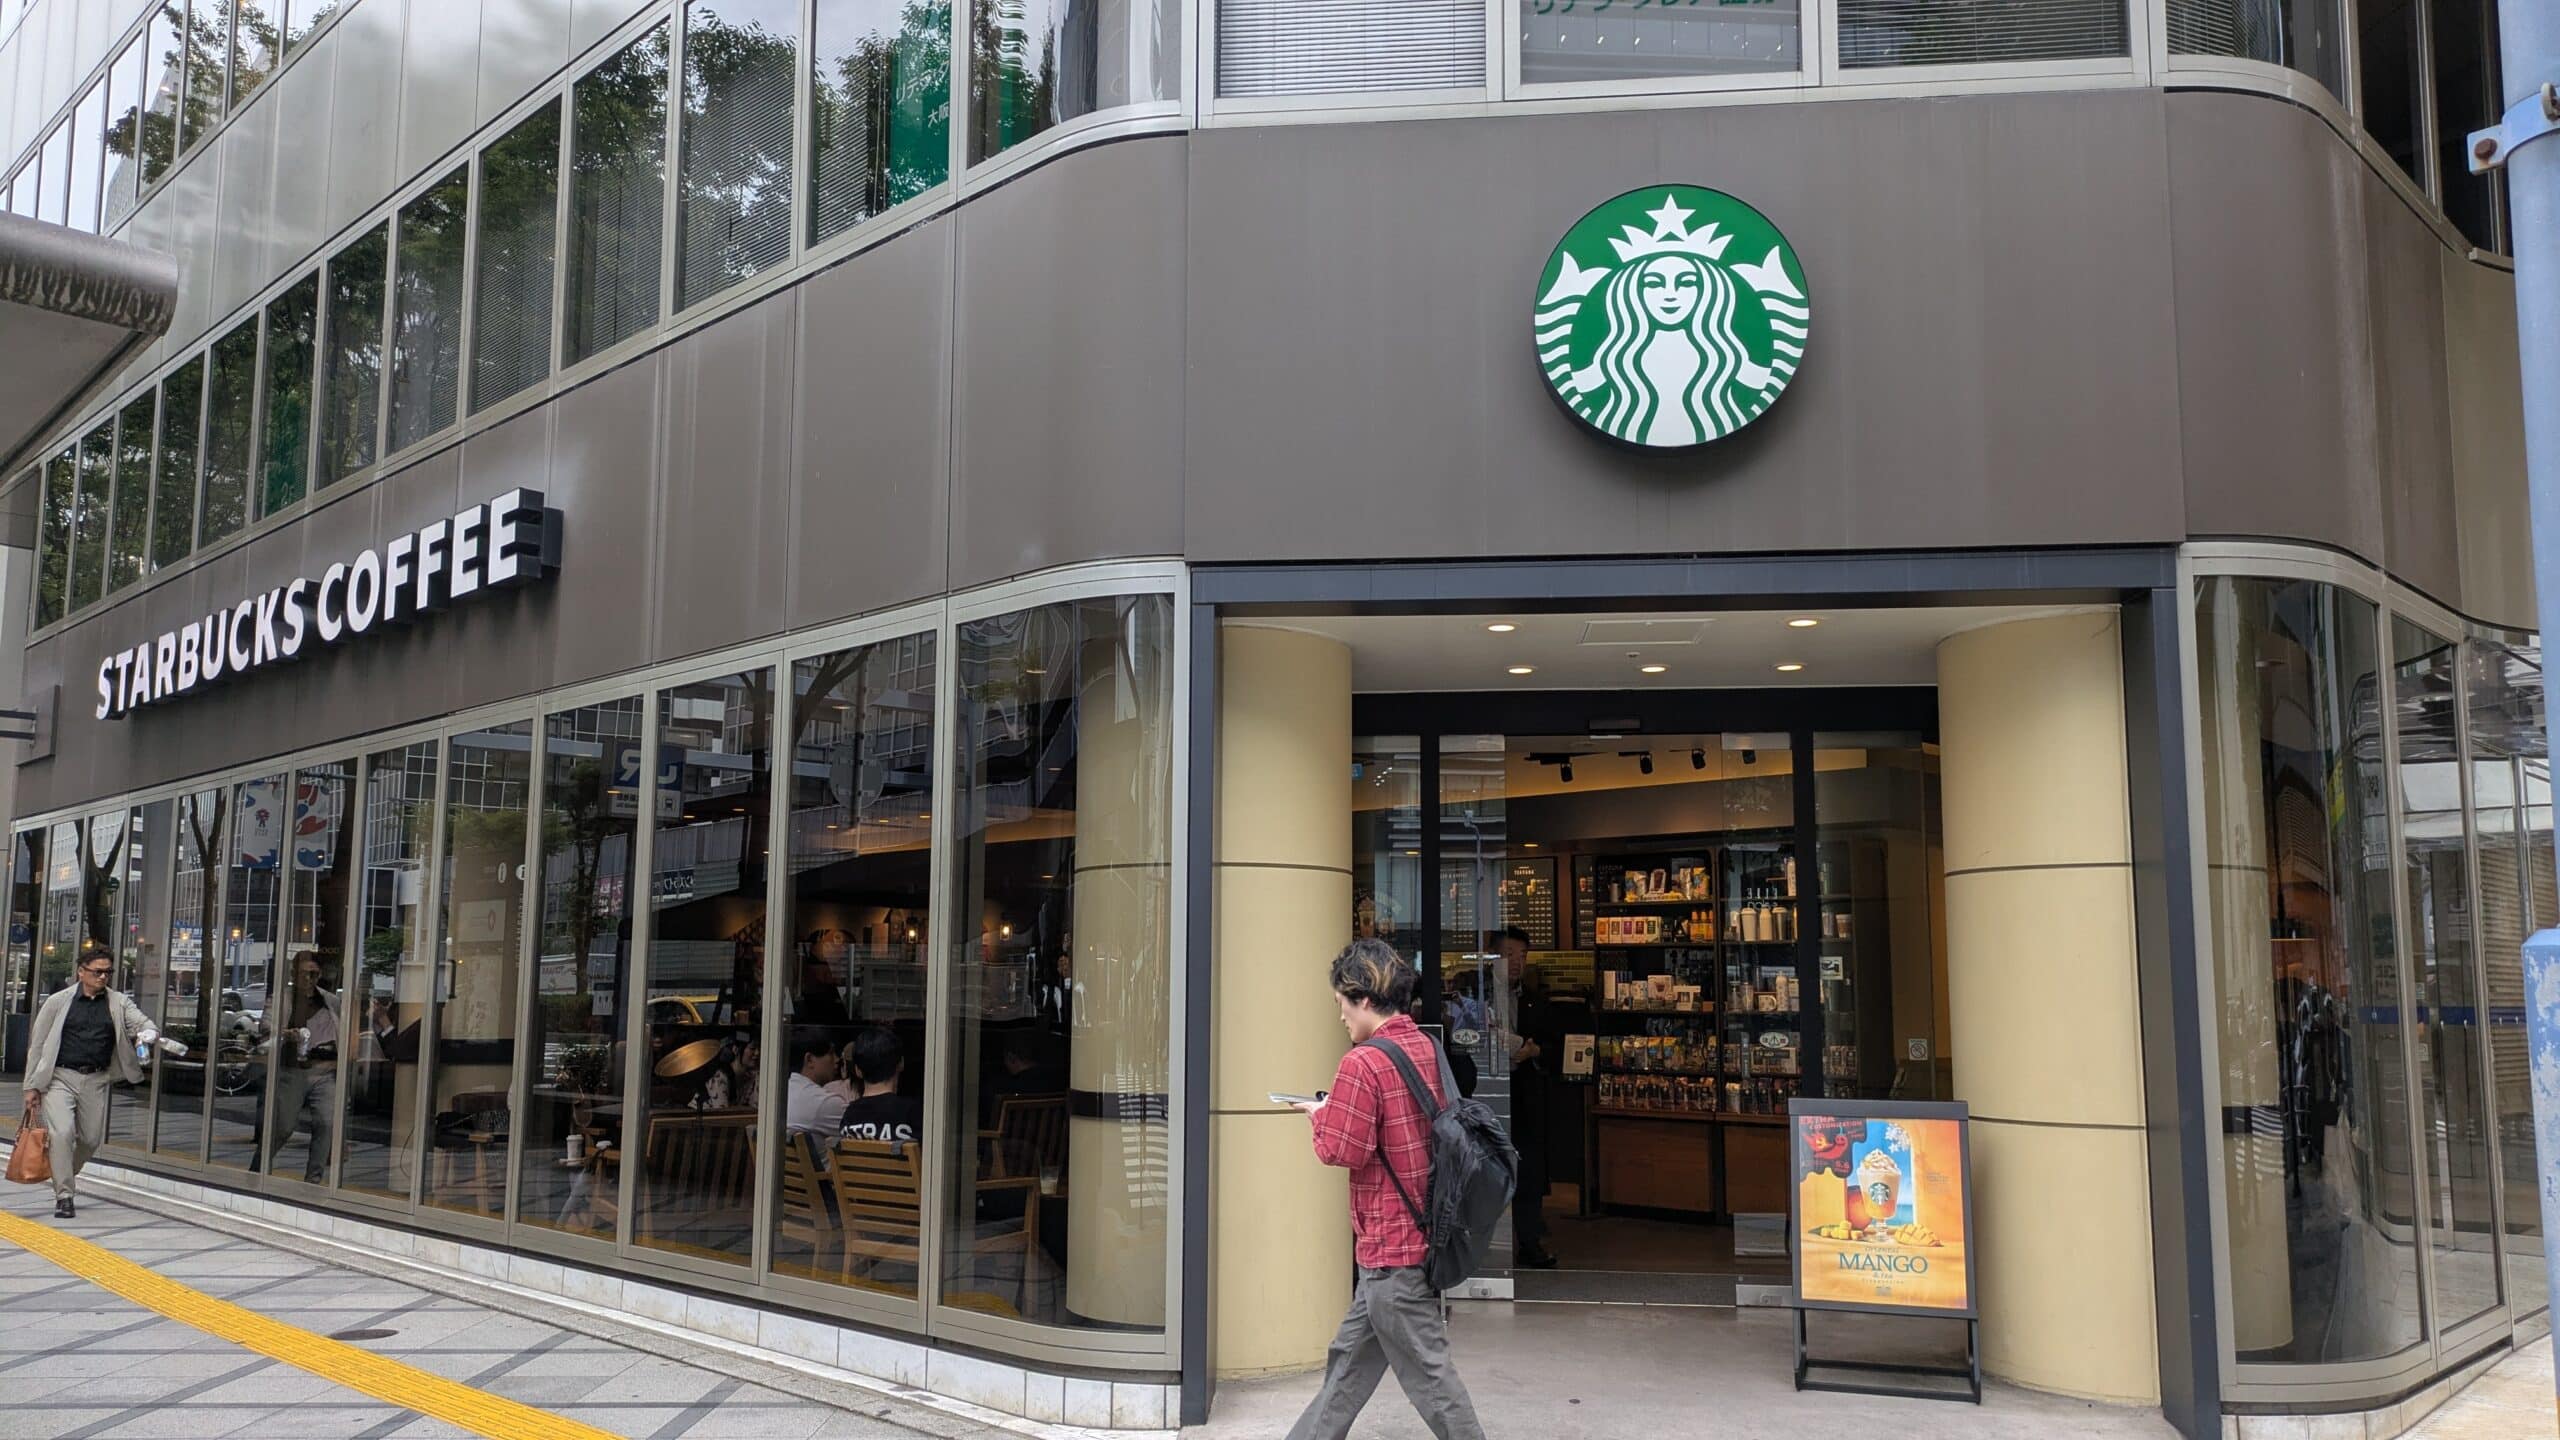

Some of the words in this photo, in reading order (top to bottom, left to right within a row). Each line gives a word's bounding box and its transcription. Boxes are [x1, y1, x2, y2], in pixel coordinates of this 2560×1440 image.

[96, 577, 306, 720] STARBUCKS
[317, 488, 521, 641] COFFEE
[1838, 1252, 1928, 1273] MANGO
